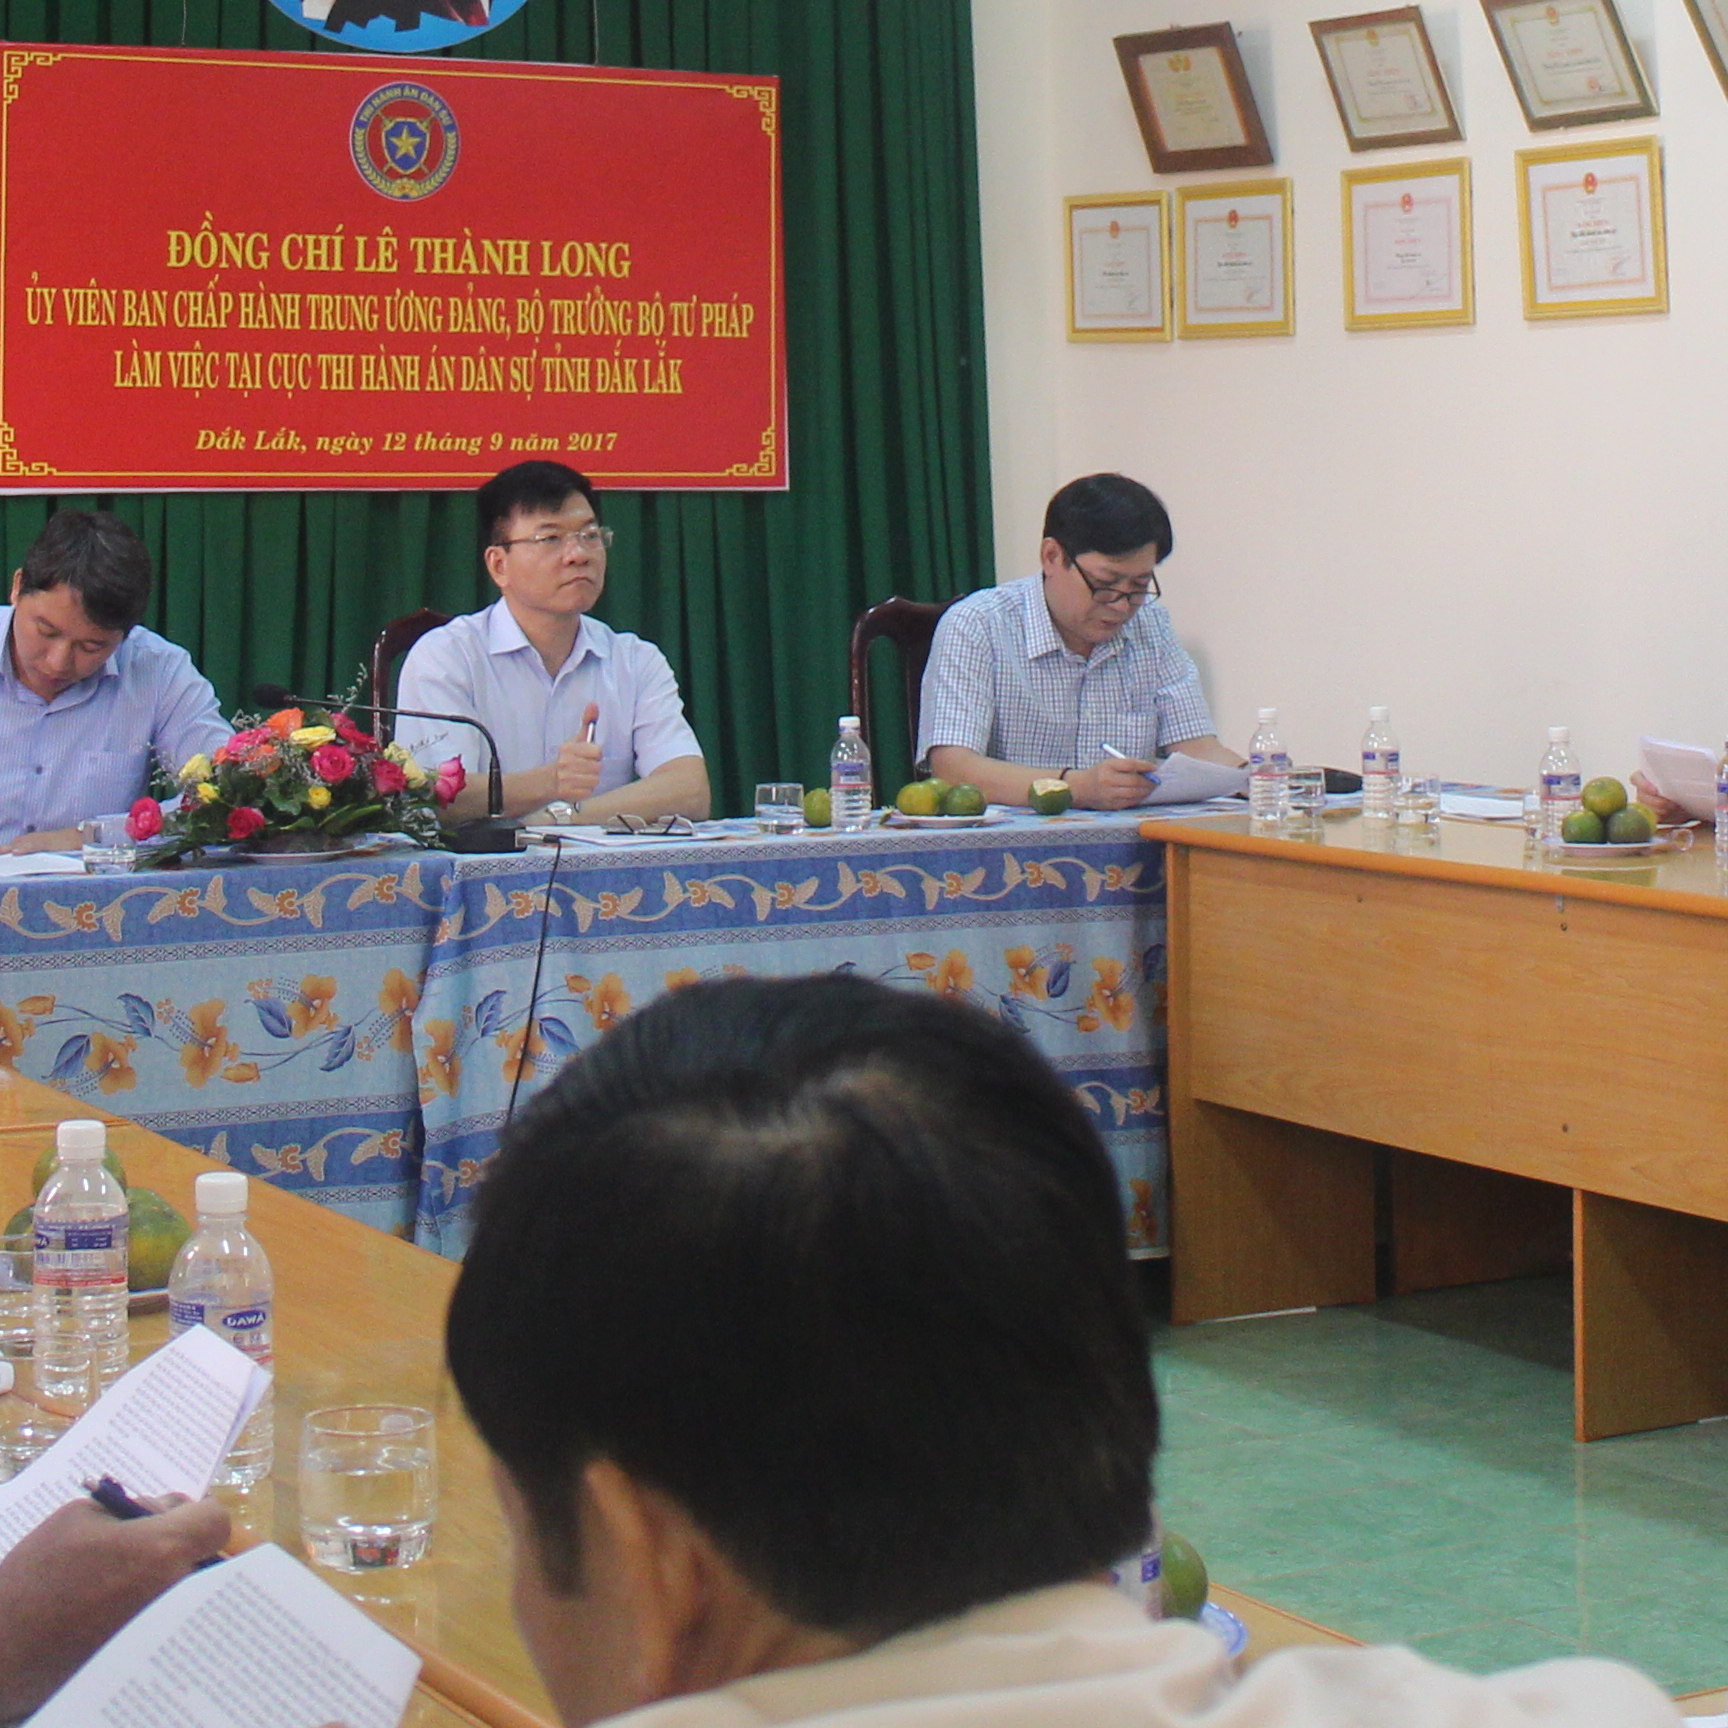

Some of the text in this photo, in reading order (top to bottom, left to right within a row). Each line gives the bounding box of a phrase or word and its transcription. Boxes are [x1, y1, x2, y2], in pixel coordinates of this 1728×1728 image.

[167, 210, 631, 279] ĐỒNG CHÍ LÊ THÀNH LONG
[26, 271, 754, 346] ỦY VIÊN BAN CHẤP HÀNH TRUNG ƯƠNG ĐẢNG, BỘ TRƯỞNG BỘ TƯ PHÁP
[114, 339, 683, 401] LÀM VIỆC TẠI CỤC THI HÀNH ÁN DÂN SỰ TỈNH ĐẮK LẮK
[195, 426, 617, 456] Đắk Lắk, ngày 12 tháng 9 năm 2017
[227, 1312, 265, 1326] DAWA
